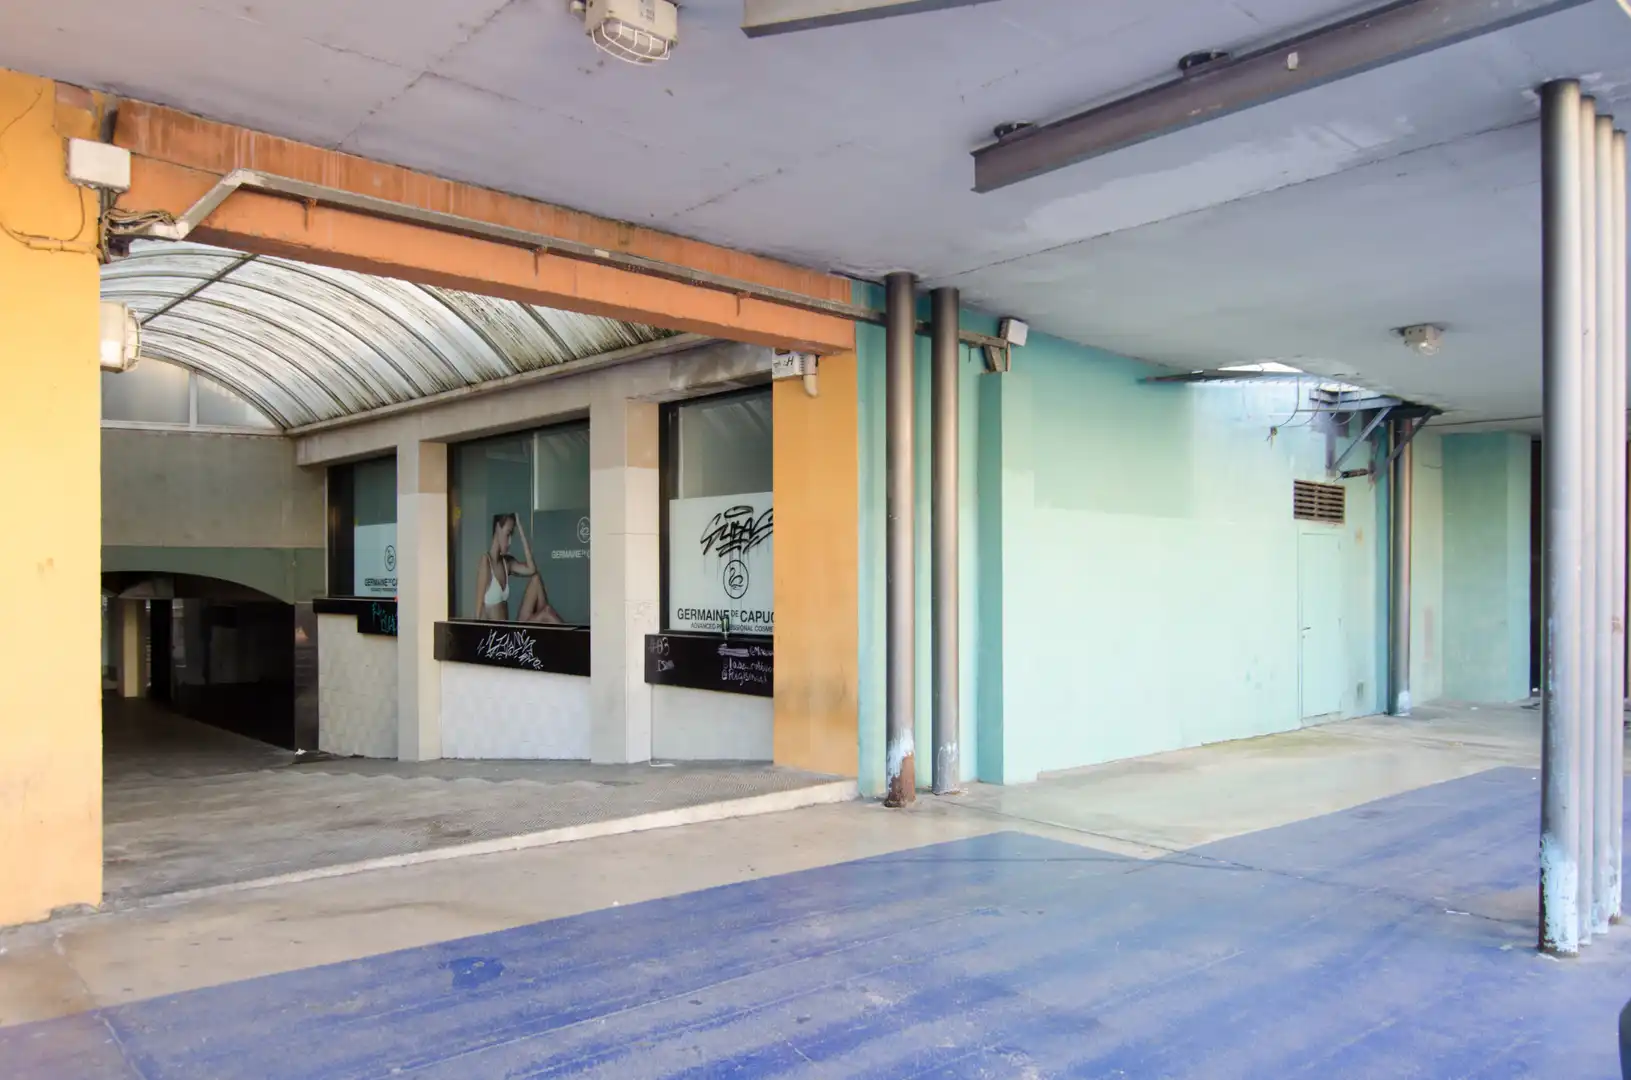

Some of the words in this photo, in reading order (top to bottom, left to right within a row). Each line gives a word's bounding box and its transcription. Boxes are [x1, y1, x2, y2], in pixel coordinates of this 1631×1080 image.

[677, 607, 730, 622] GERMAINE
[730, 609, 739, 618] DE
[690, 622, 716, 630] ADVANCED
